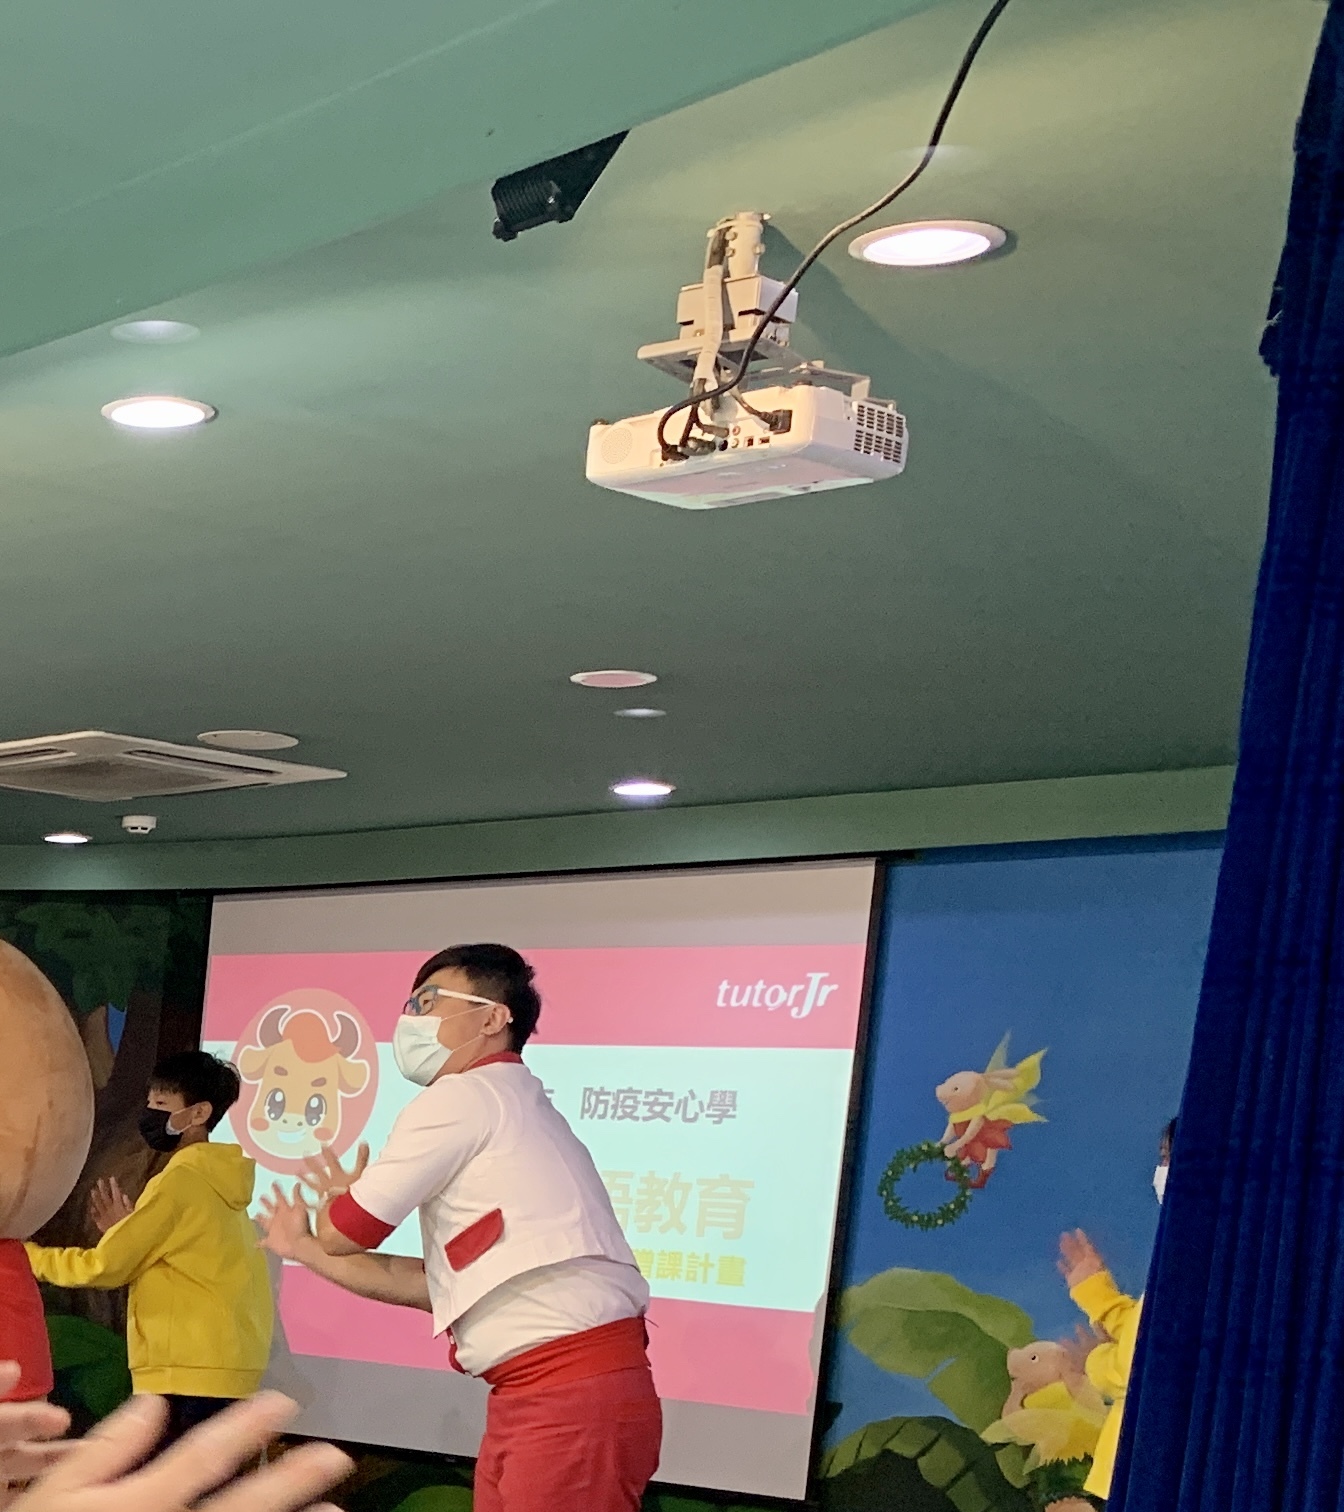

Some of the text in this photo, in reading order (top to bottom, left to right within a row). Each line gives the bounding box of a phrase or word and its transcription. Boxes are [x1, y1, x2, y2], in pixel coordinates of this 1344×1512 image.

[716, 972, 839, 1019] tutorJr
[580, 1086, 738, 1125] 防疫安心學
